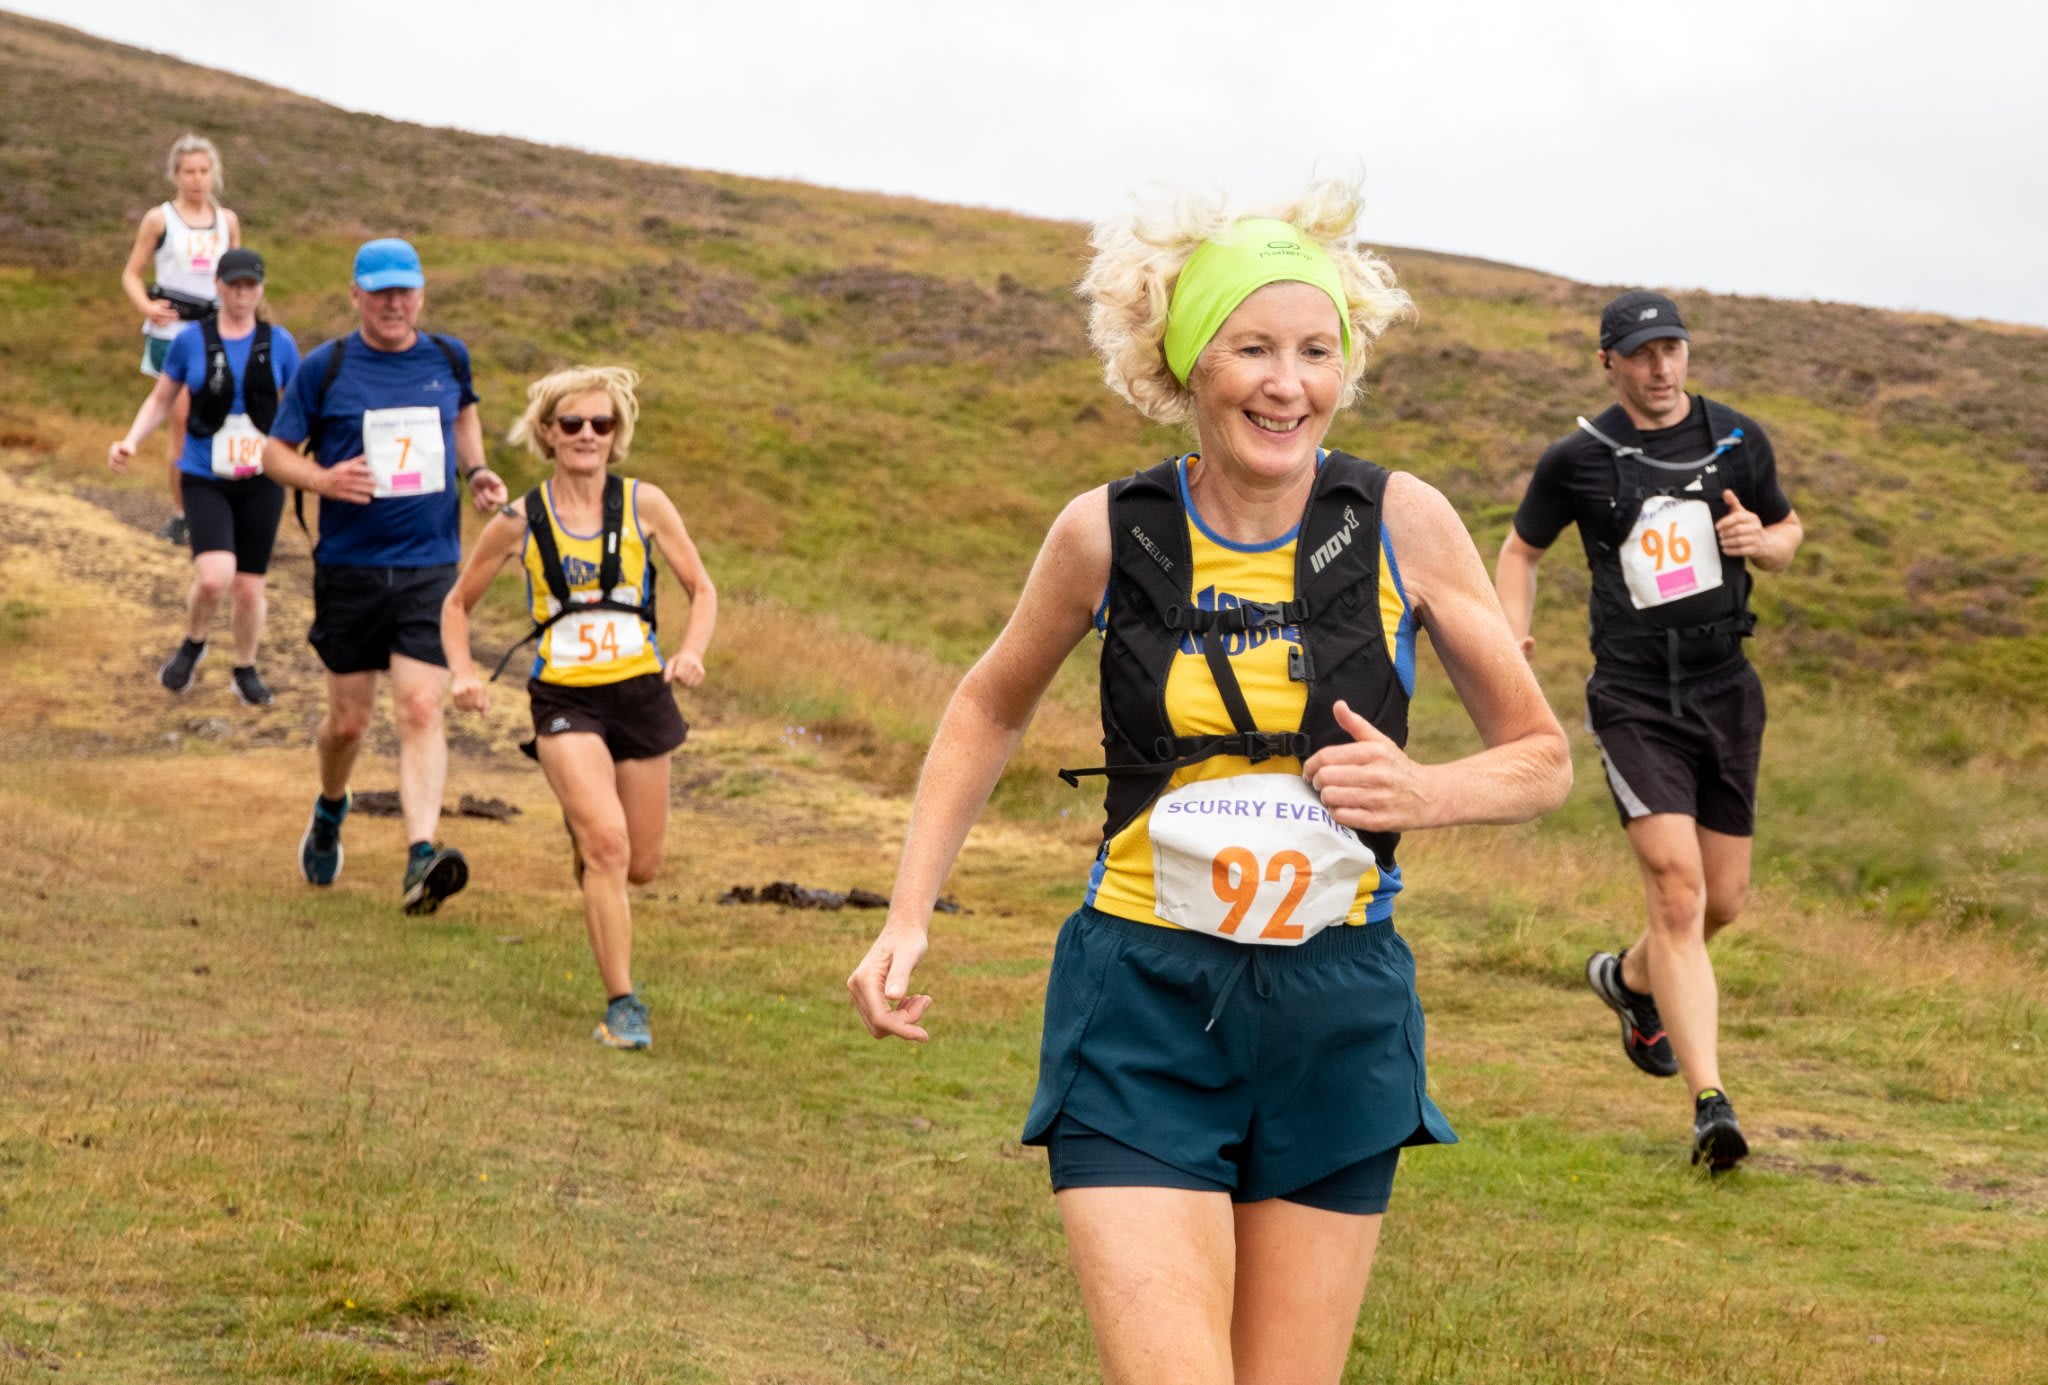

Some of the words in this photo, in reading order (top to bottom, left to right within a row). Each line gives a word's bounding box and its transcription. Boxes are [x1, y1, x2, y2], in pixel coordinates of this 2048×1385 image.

[394, 436, 412, 470] 7
[1641, 520, 1692, 571] 96
[578, 621, 620, 662] 54
[1167, 799, 1267, 818] SCURRY
[1211, 845, 1313, 940] 92
